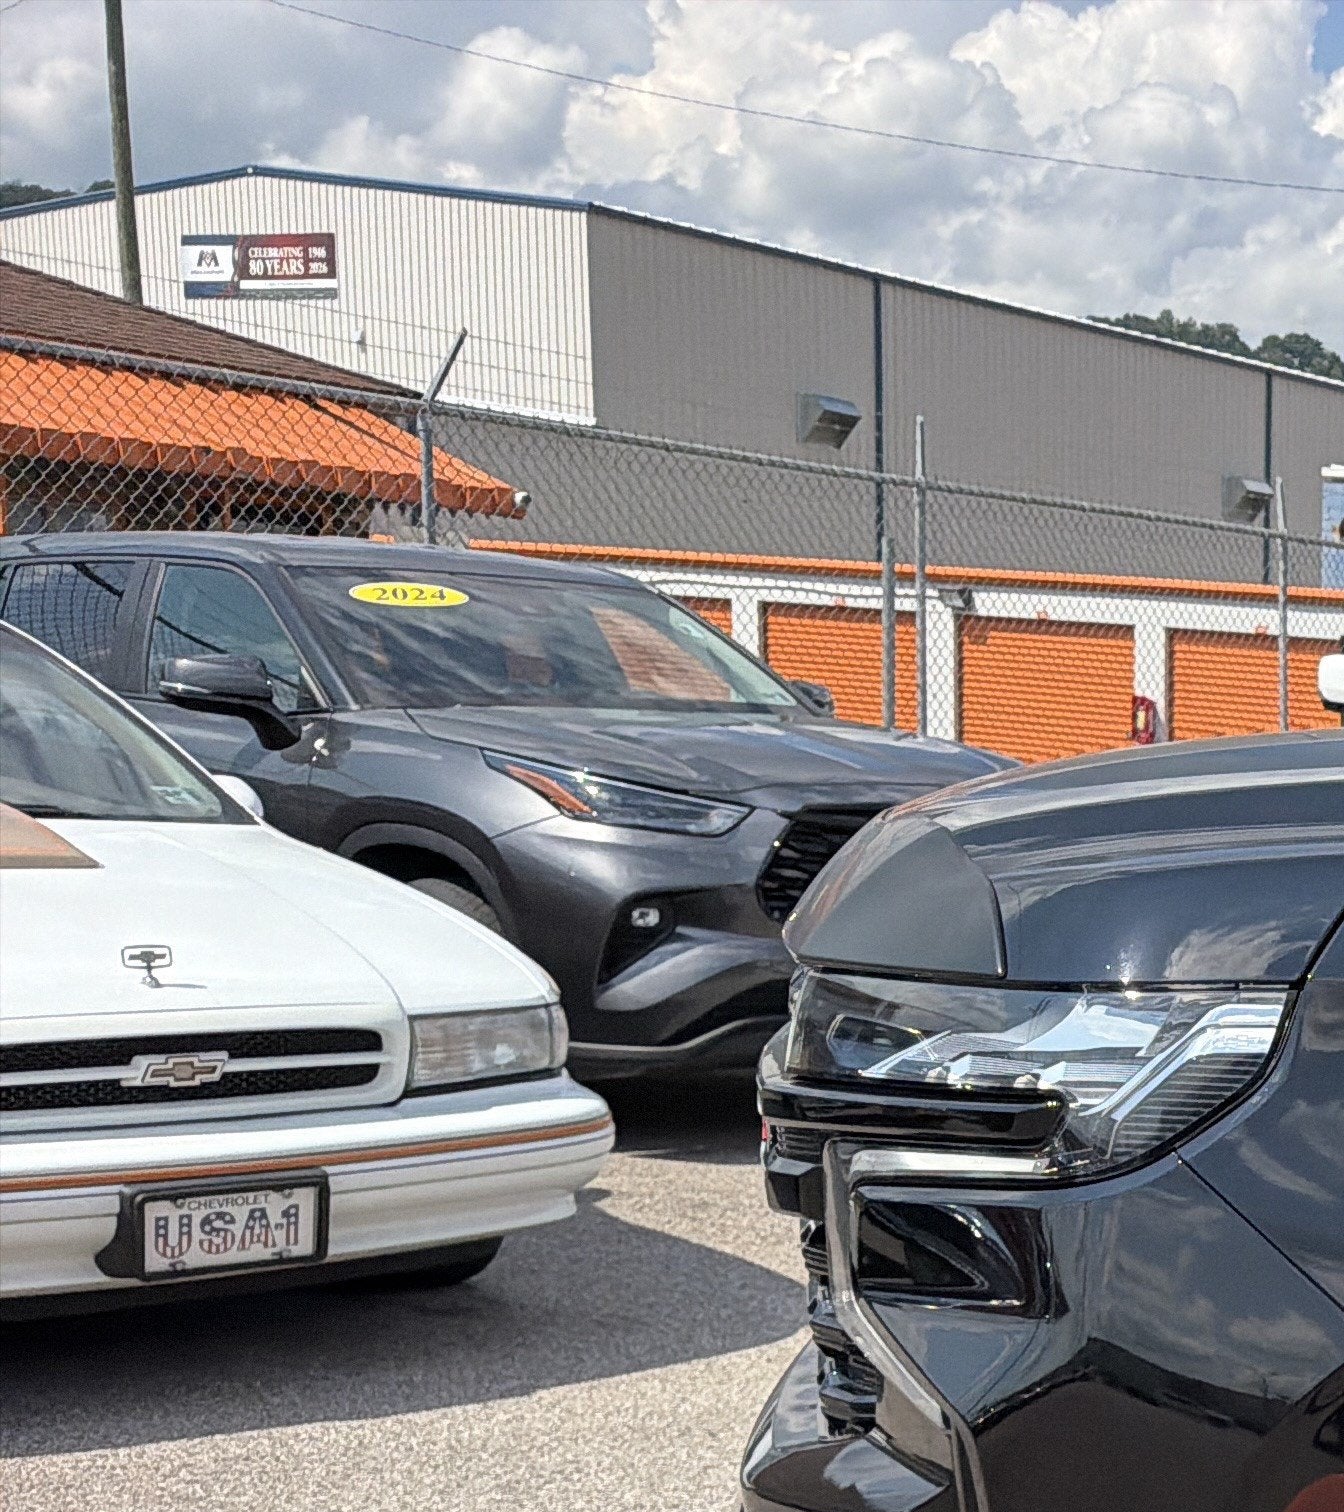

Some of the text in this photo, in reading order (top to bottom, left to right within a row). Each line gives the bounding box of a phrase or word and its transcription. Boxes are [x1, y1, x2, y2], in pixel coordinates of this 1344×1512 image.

[249, 247, 303, 258] CELEBRATING
[249, 259, 264, 275] 80
[265, 259, 304, 275] YEARS
[372, 587, 447, 601] 2024
[187, 1193, 270, 1211] CHEVROLET
